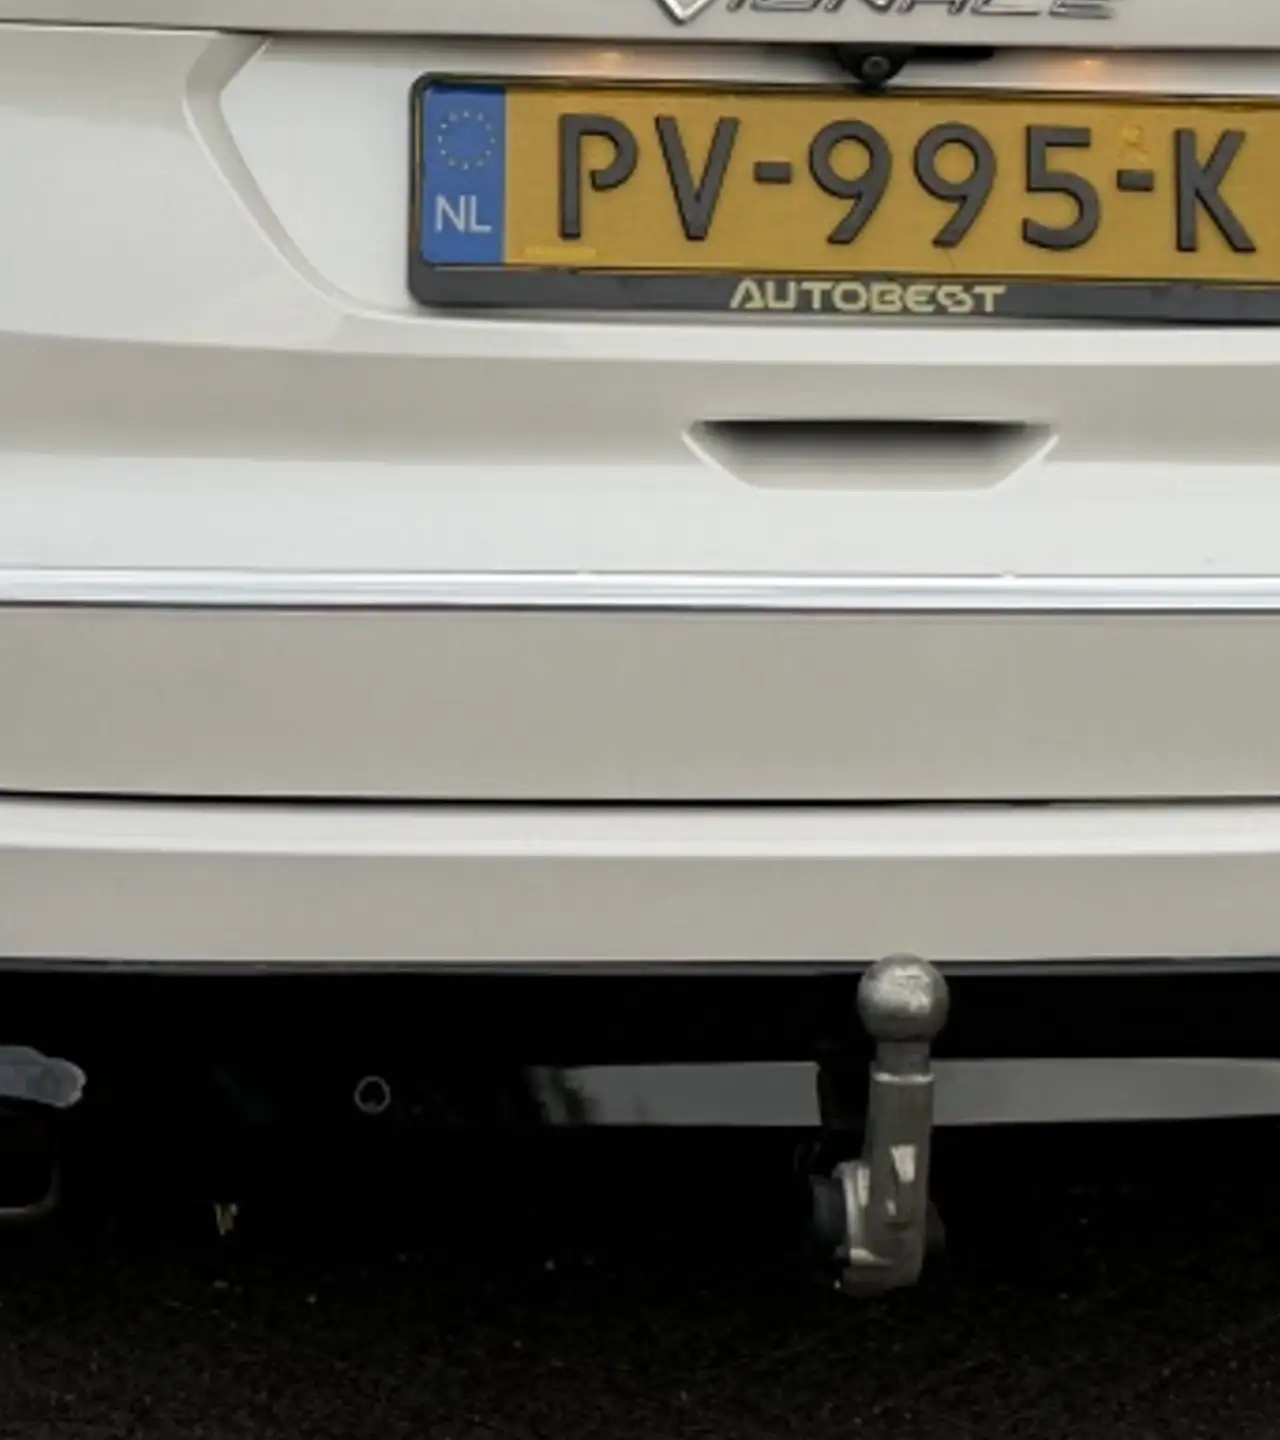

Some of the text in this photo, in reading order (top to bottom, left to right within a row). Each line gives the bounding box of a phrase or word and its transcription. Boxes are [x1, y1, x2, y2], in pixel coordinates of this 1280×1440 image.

[556, 113, 1256, 254] PV-995-K
[434, 195, 492, 235] NL
[729, 277, 1006, 314] AUTOBEST
